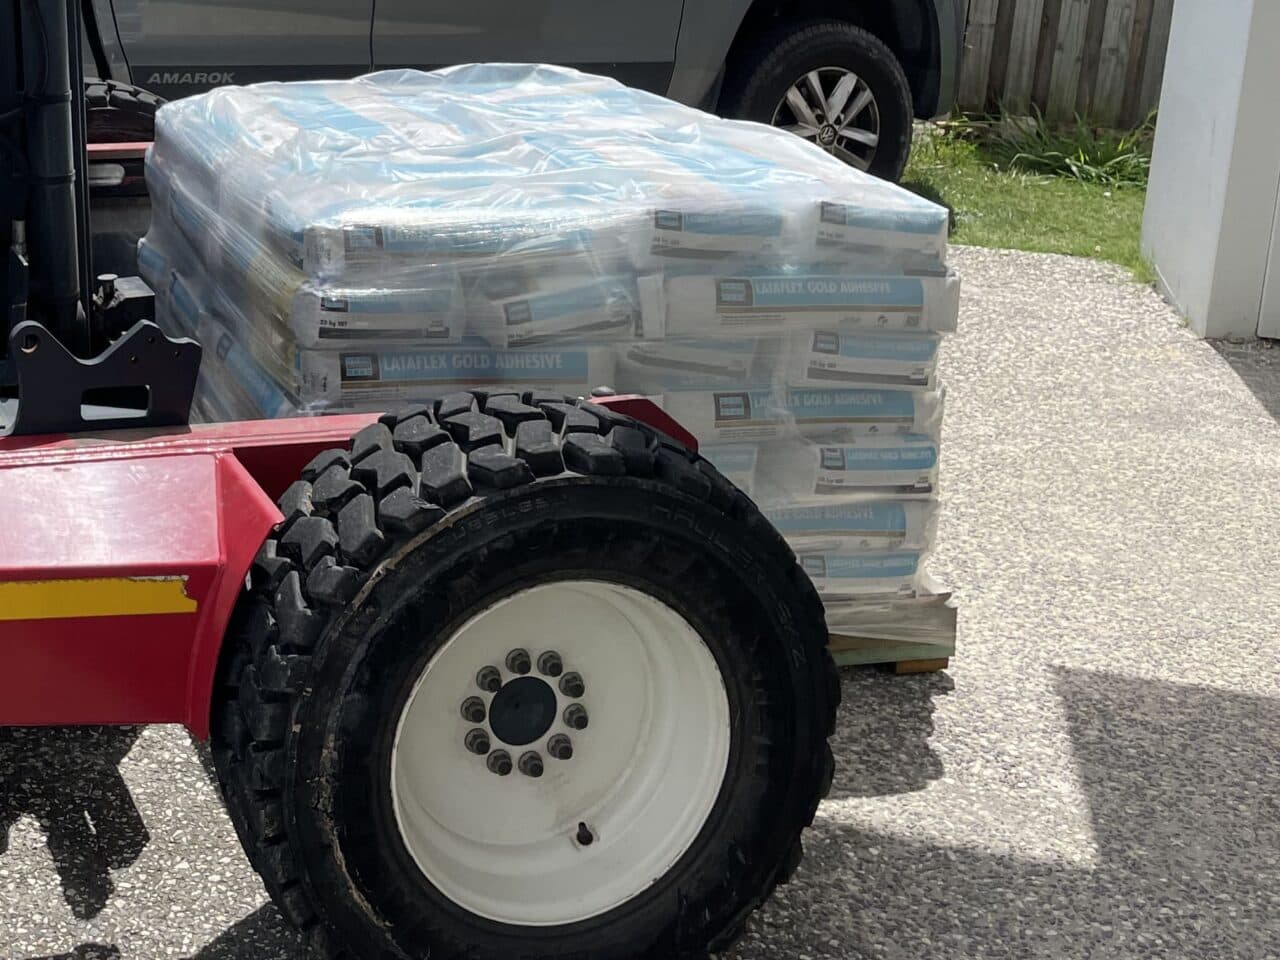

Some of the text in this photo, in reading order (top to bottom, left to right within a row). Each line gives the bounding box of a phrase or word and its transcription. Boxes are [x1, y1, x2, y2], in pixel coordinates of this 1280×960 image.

[147, 72, 235, 84] AMAROK
[807, 281, 837, 294] GOLD
[840, 280, 891, 293] ADHESIVE
[384, 354, 448, 371] LATAFLEX
[452, 353, 490, 370] GOLD
[495, 353, 563, 370] ADHESIVE
